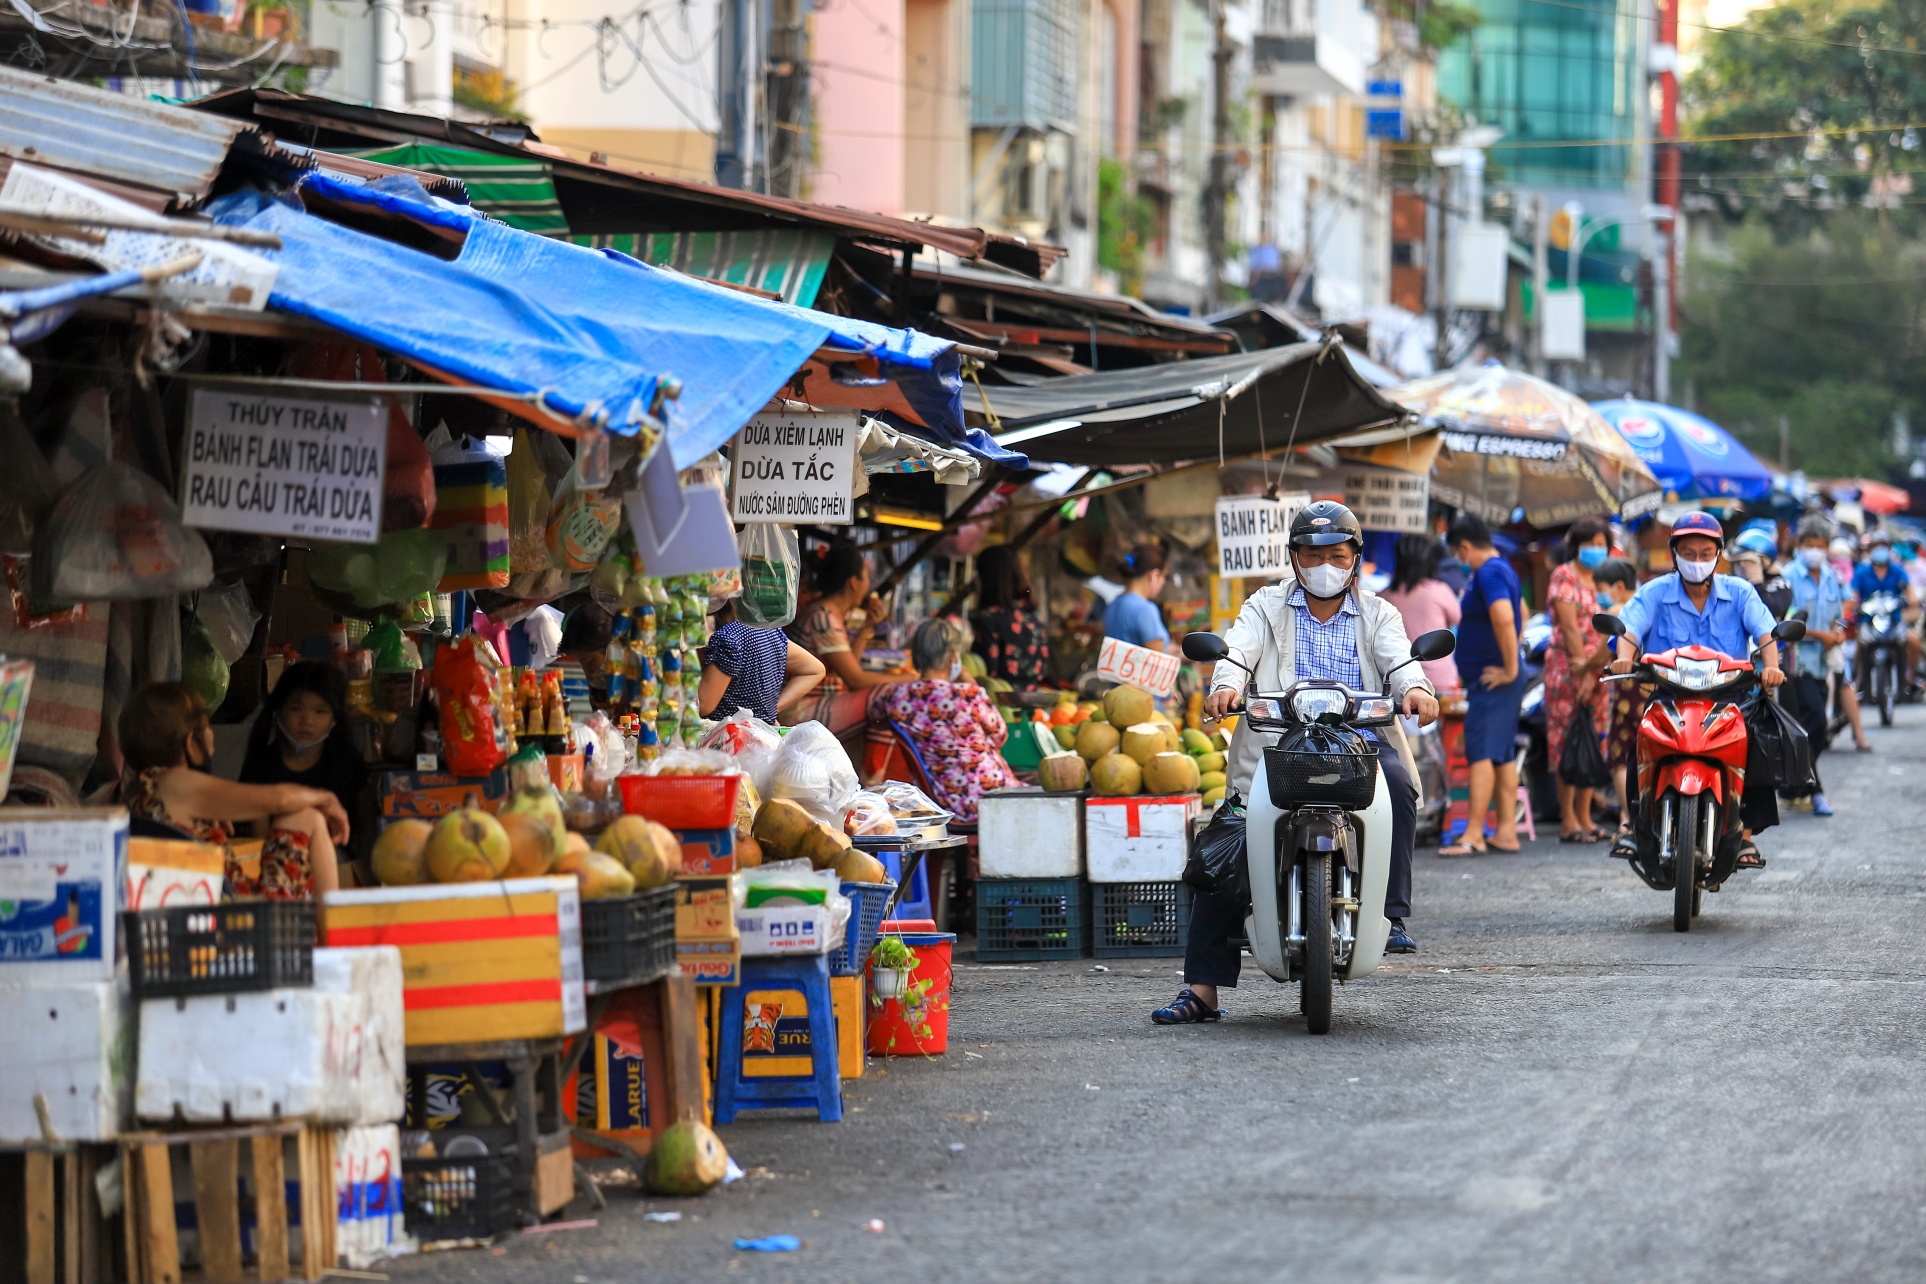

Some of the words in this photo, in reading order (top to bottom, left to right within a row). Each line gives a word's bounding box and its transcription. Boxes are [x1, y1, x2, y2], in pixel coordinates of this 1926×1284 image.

[229, 400, 285, 426] THÚY
[193, 424, 243, 466] BÁNH
[246, 435, 293, 471] FLAN
[297, 435, 337, 475] TRÁI
[744, 421, 771, 446] DỪA
[773, 421, 806, 446] XIÊM
[808, 427, 844, 450] LẠNH
[1477, 434, 1567, 463] ESPRESSO
[741, 456, 784, 480] DỪA
[791, 453, 835, 481] TẮC
[190, 475, 232, 509] RAU
[283, 478, 327, 517] TRÁI
[739, 490, 764, 514] NƯỚC
[765, 491, 785, 515] SÂM
[787, 491, 819, 516] ĐƯỜNG
[821, 492, 846, 516] PHÈN
[1220, 504, 1256, 538] BÁNH
[1260, 507, 1286, 534] FLAN
[1223, 545, 1253, 571] RAU
